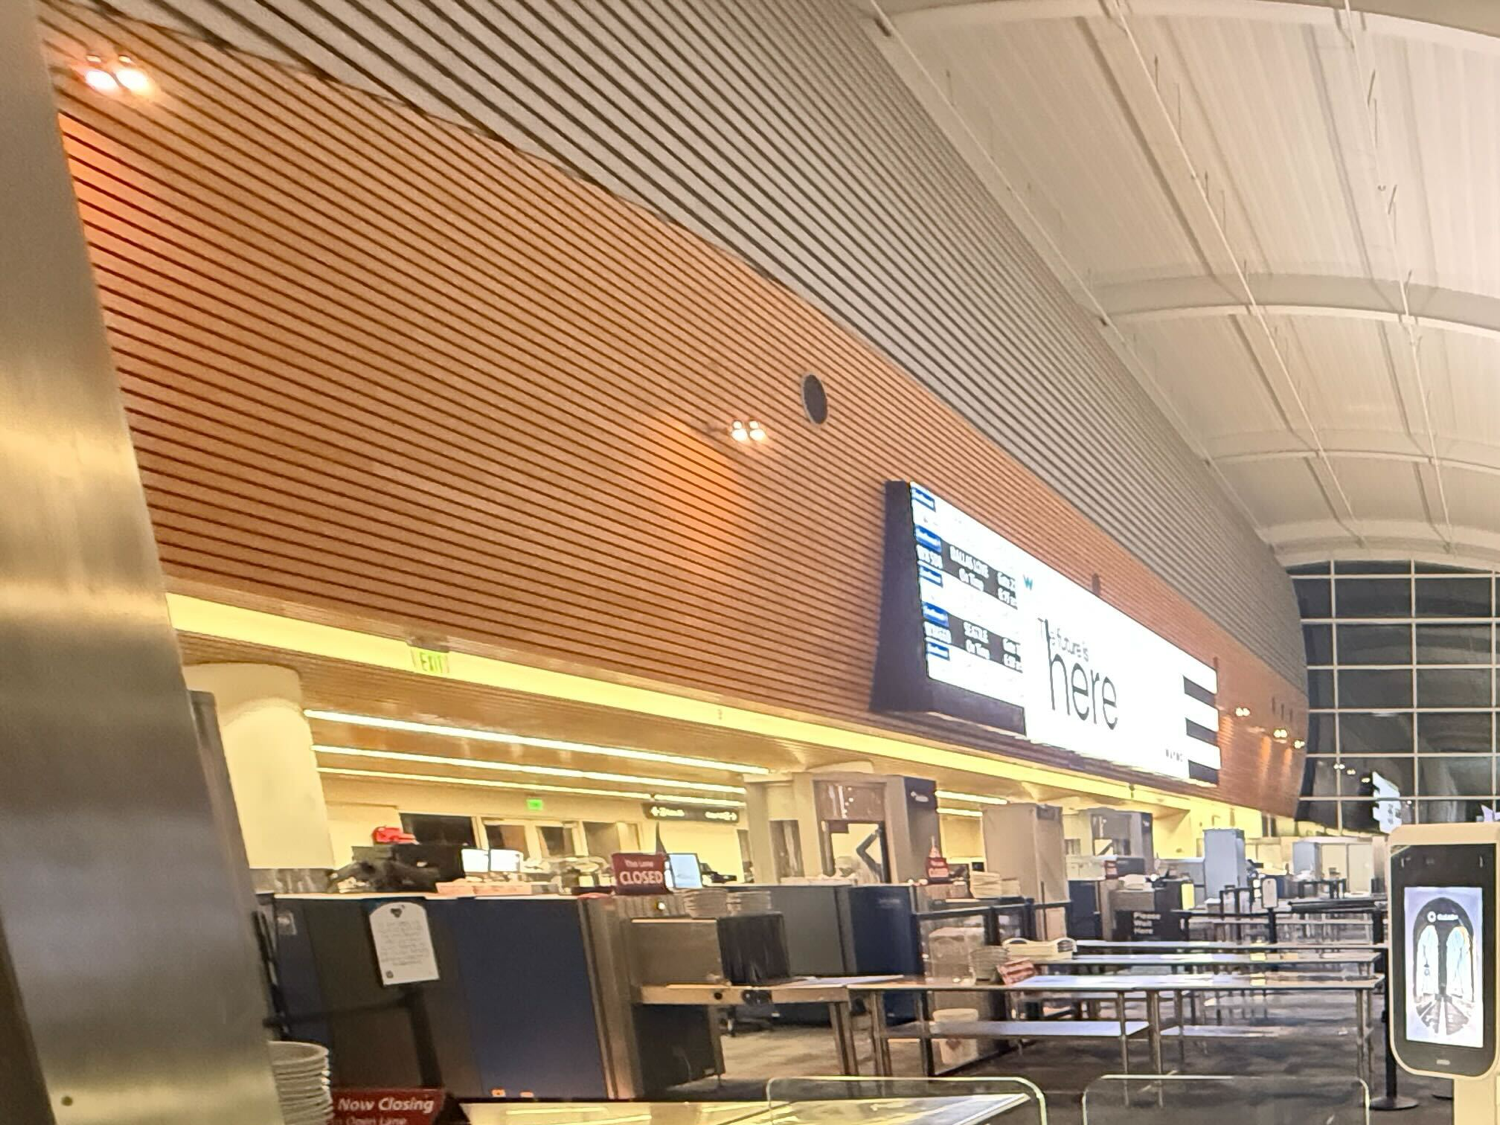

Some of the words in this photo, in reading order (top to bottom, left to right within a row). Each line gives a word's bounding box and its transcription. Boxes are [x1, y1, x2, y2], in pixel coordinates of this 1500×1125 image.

[419, 651, 444, 674] EXIT
[1044, 618, 1118, 730] here
[619, 870, 663, 886] CLOSED
[338, 1097, 375, 1112] Now
[378, 1095, 435, 1114] Closing
